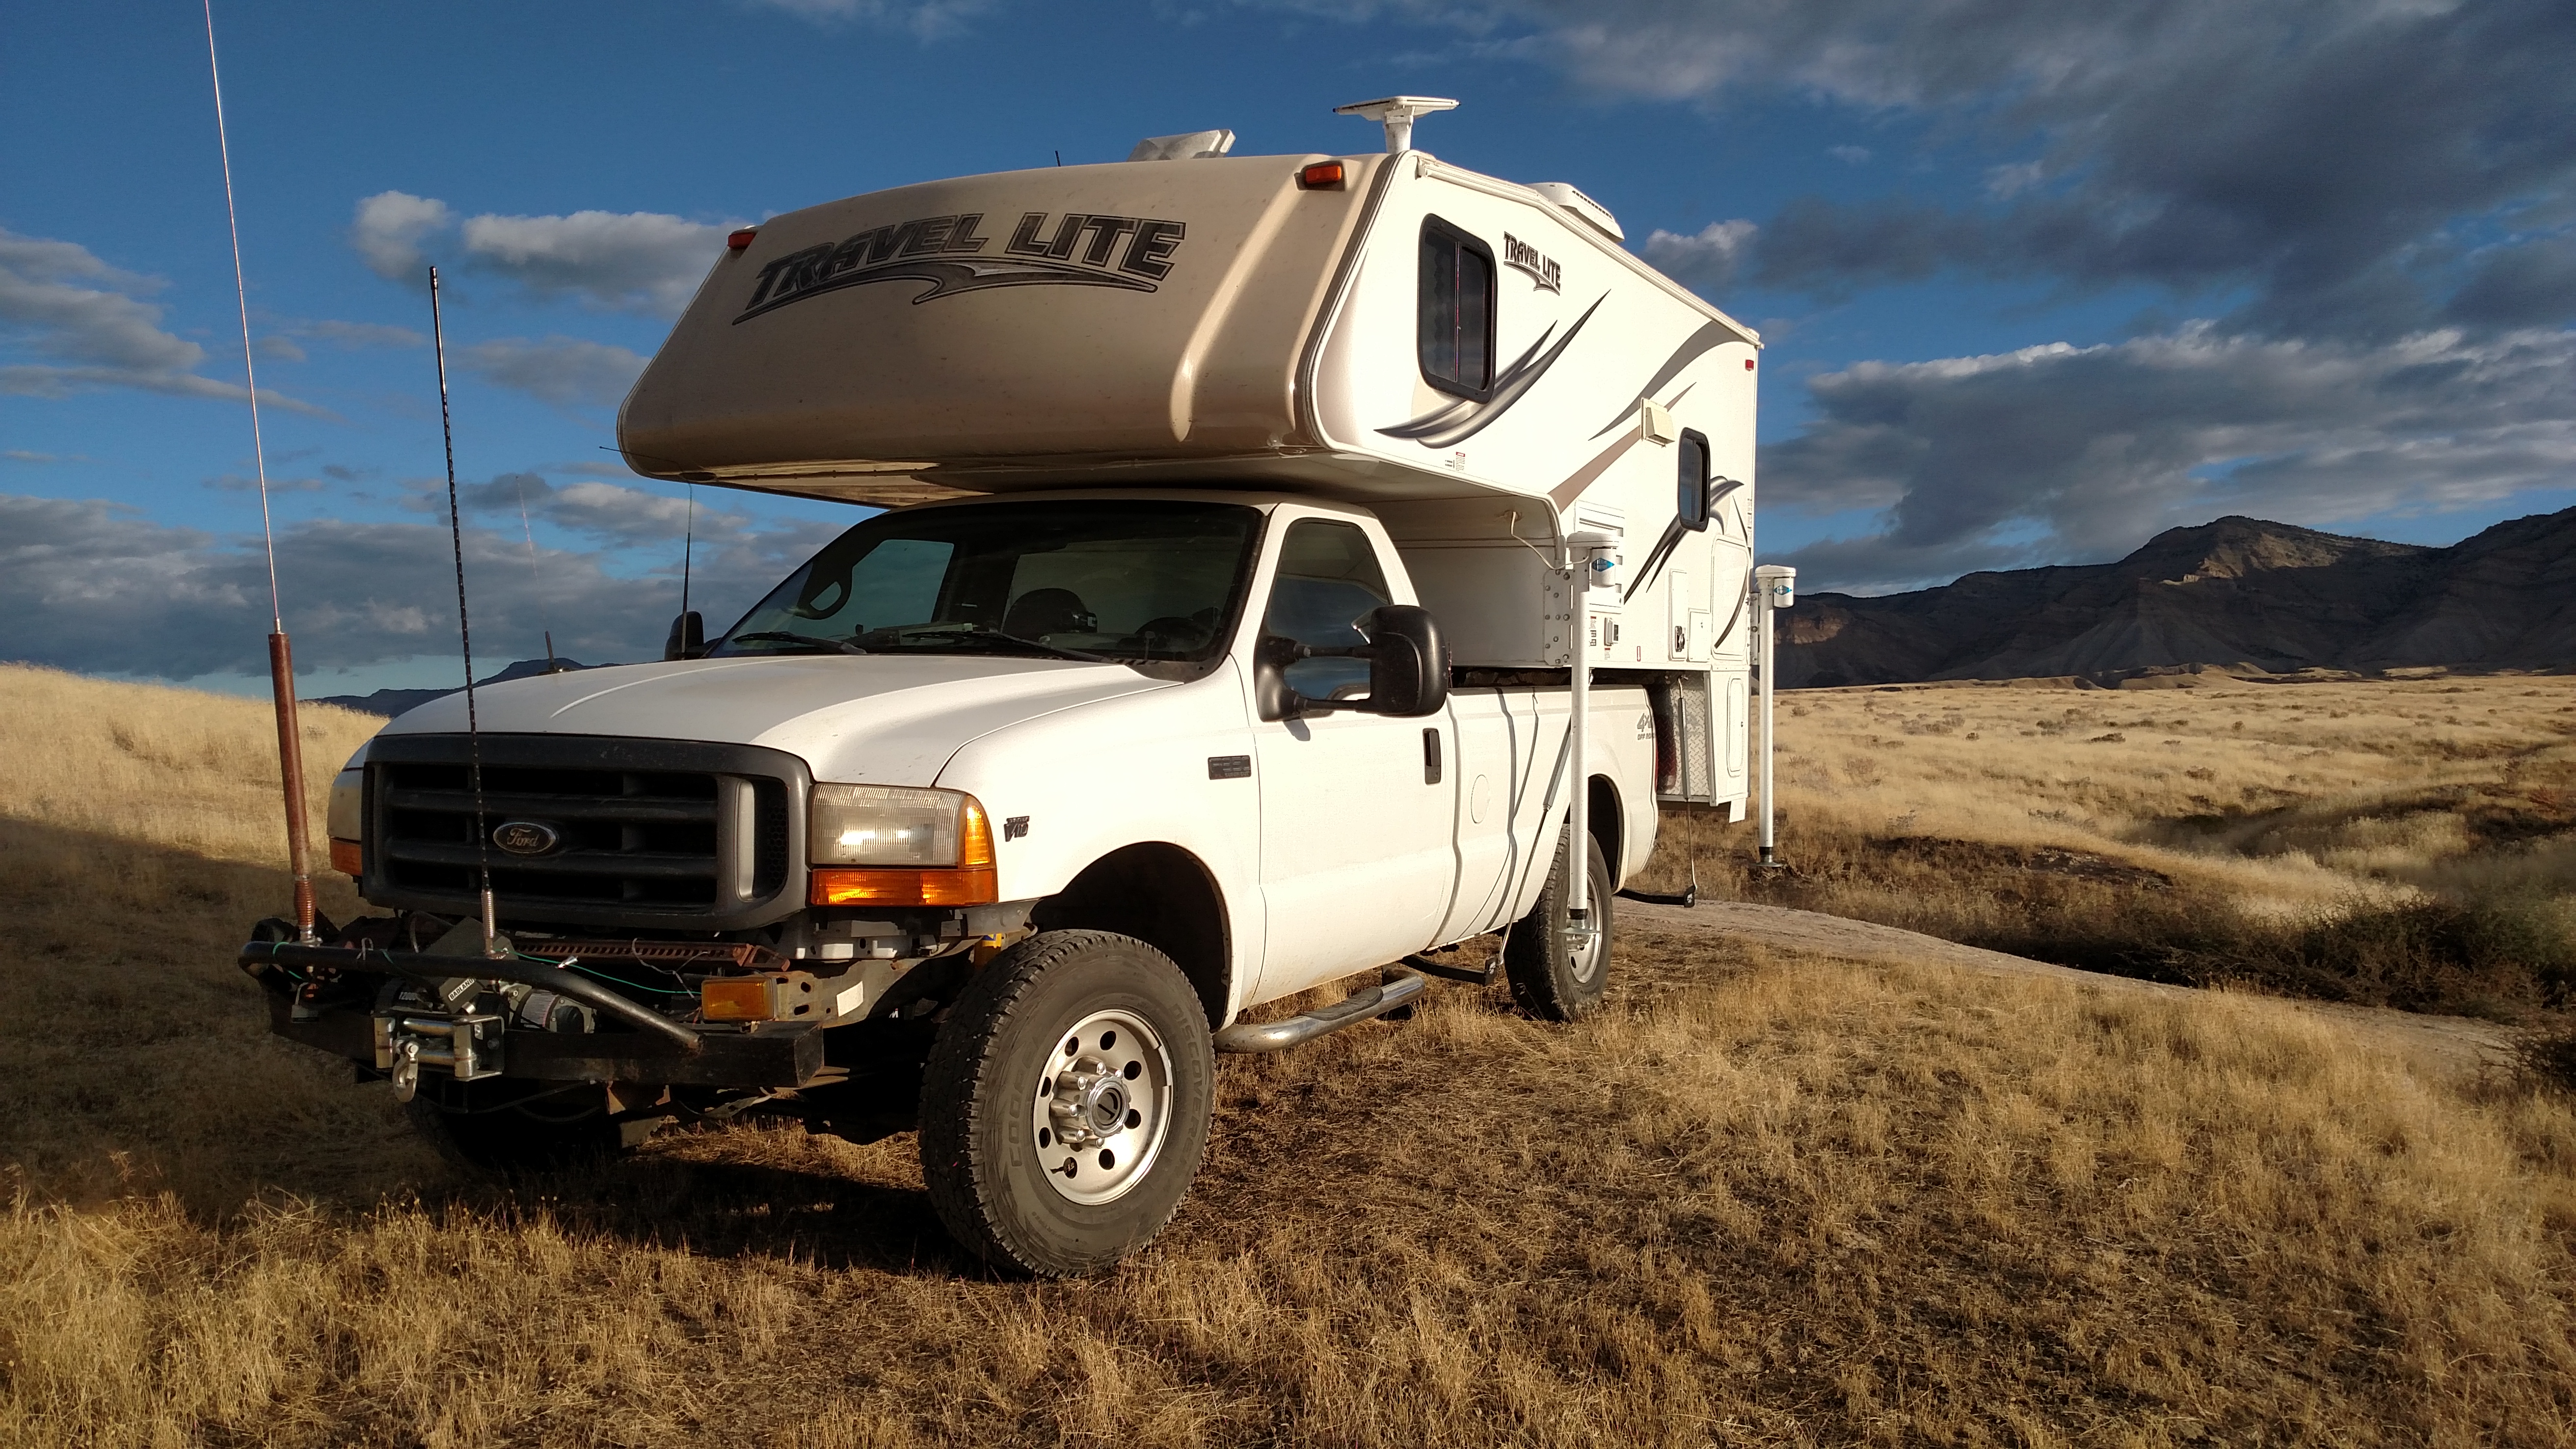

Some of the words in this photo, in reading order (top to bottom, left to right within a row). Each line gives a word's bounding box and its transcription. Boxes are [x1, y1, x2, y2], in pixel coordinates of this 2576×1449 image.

[746, 213, 990, 310] TRAVEL
[1004, 212, 1186, 281] LITE
[1503, 231, 1540, 272] TRAVEL
[1542, 254, 1561, 292] LITE
[507, 828, 539, 847] Ford
[449, 978, 474, 1000] BADLAND
